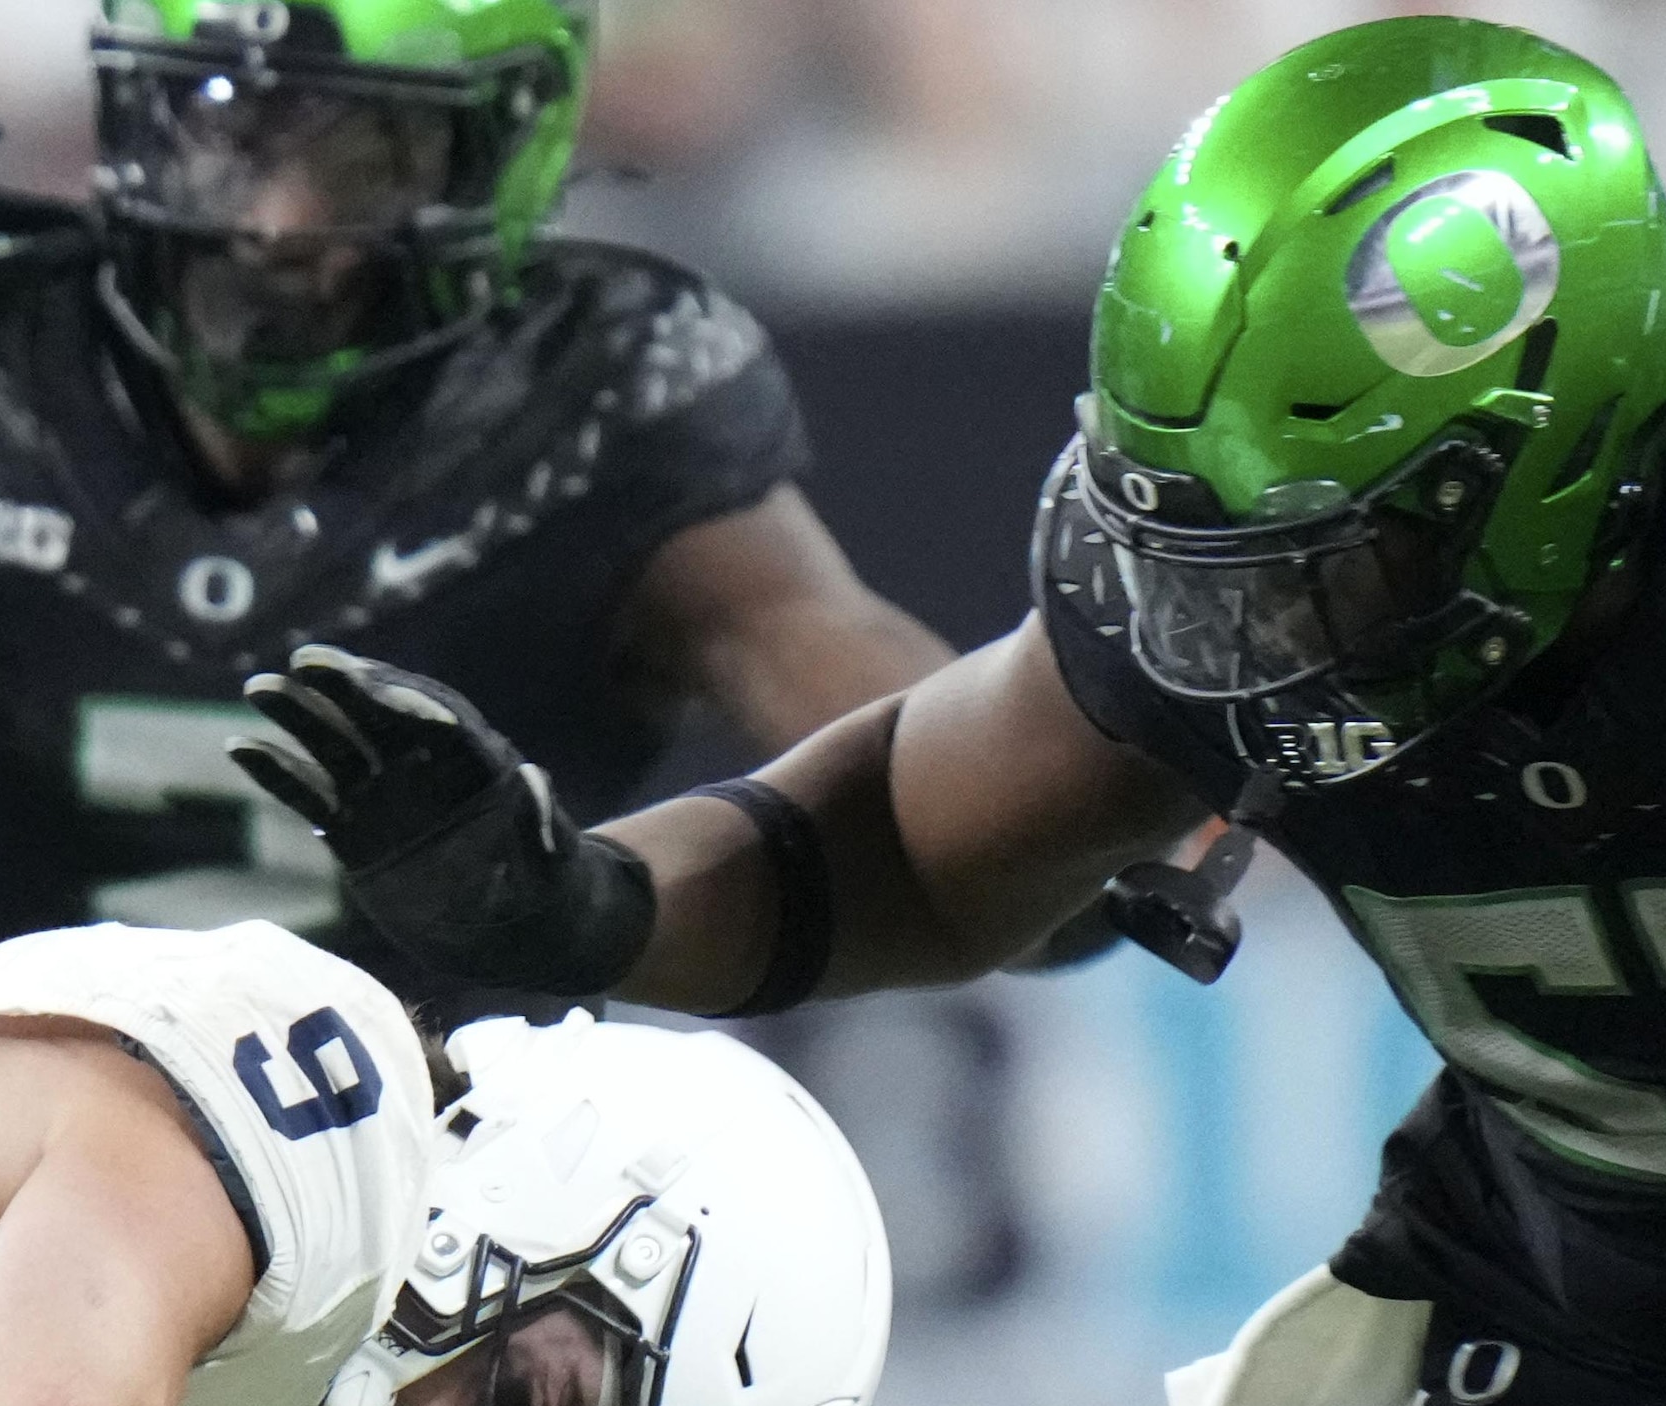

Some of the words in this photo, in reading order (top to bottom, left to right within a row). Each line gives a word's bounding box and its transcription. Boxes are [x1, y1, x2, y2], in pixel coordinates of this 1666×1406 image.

[1346, 170, 1561, 377] O
[1122, 472, 1159, 511] O
[179, 556, 254, 621] O
[1521, 761, 1587, 809] O
[233, 1005, 383, 1141] 9
[1448, 1340, 1520, 1406] O
